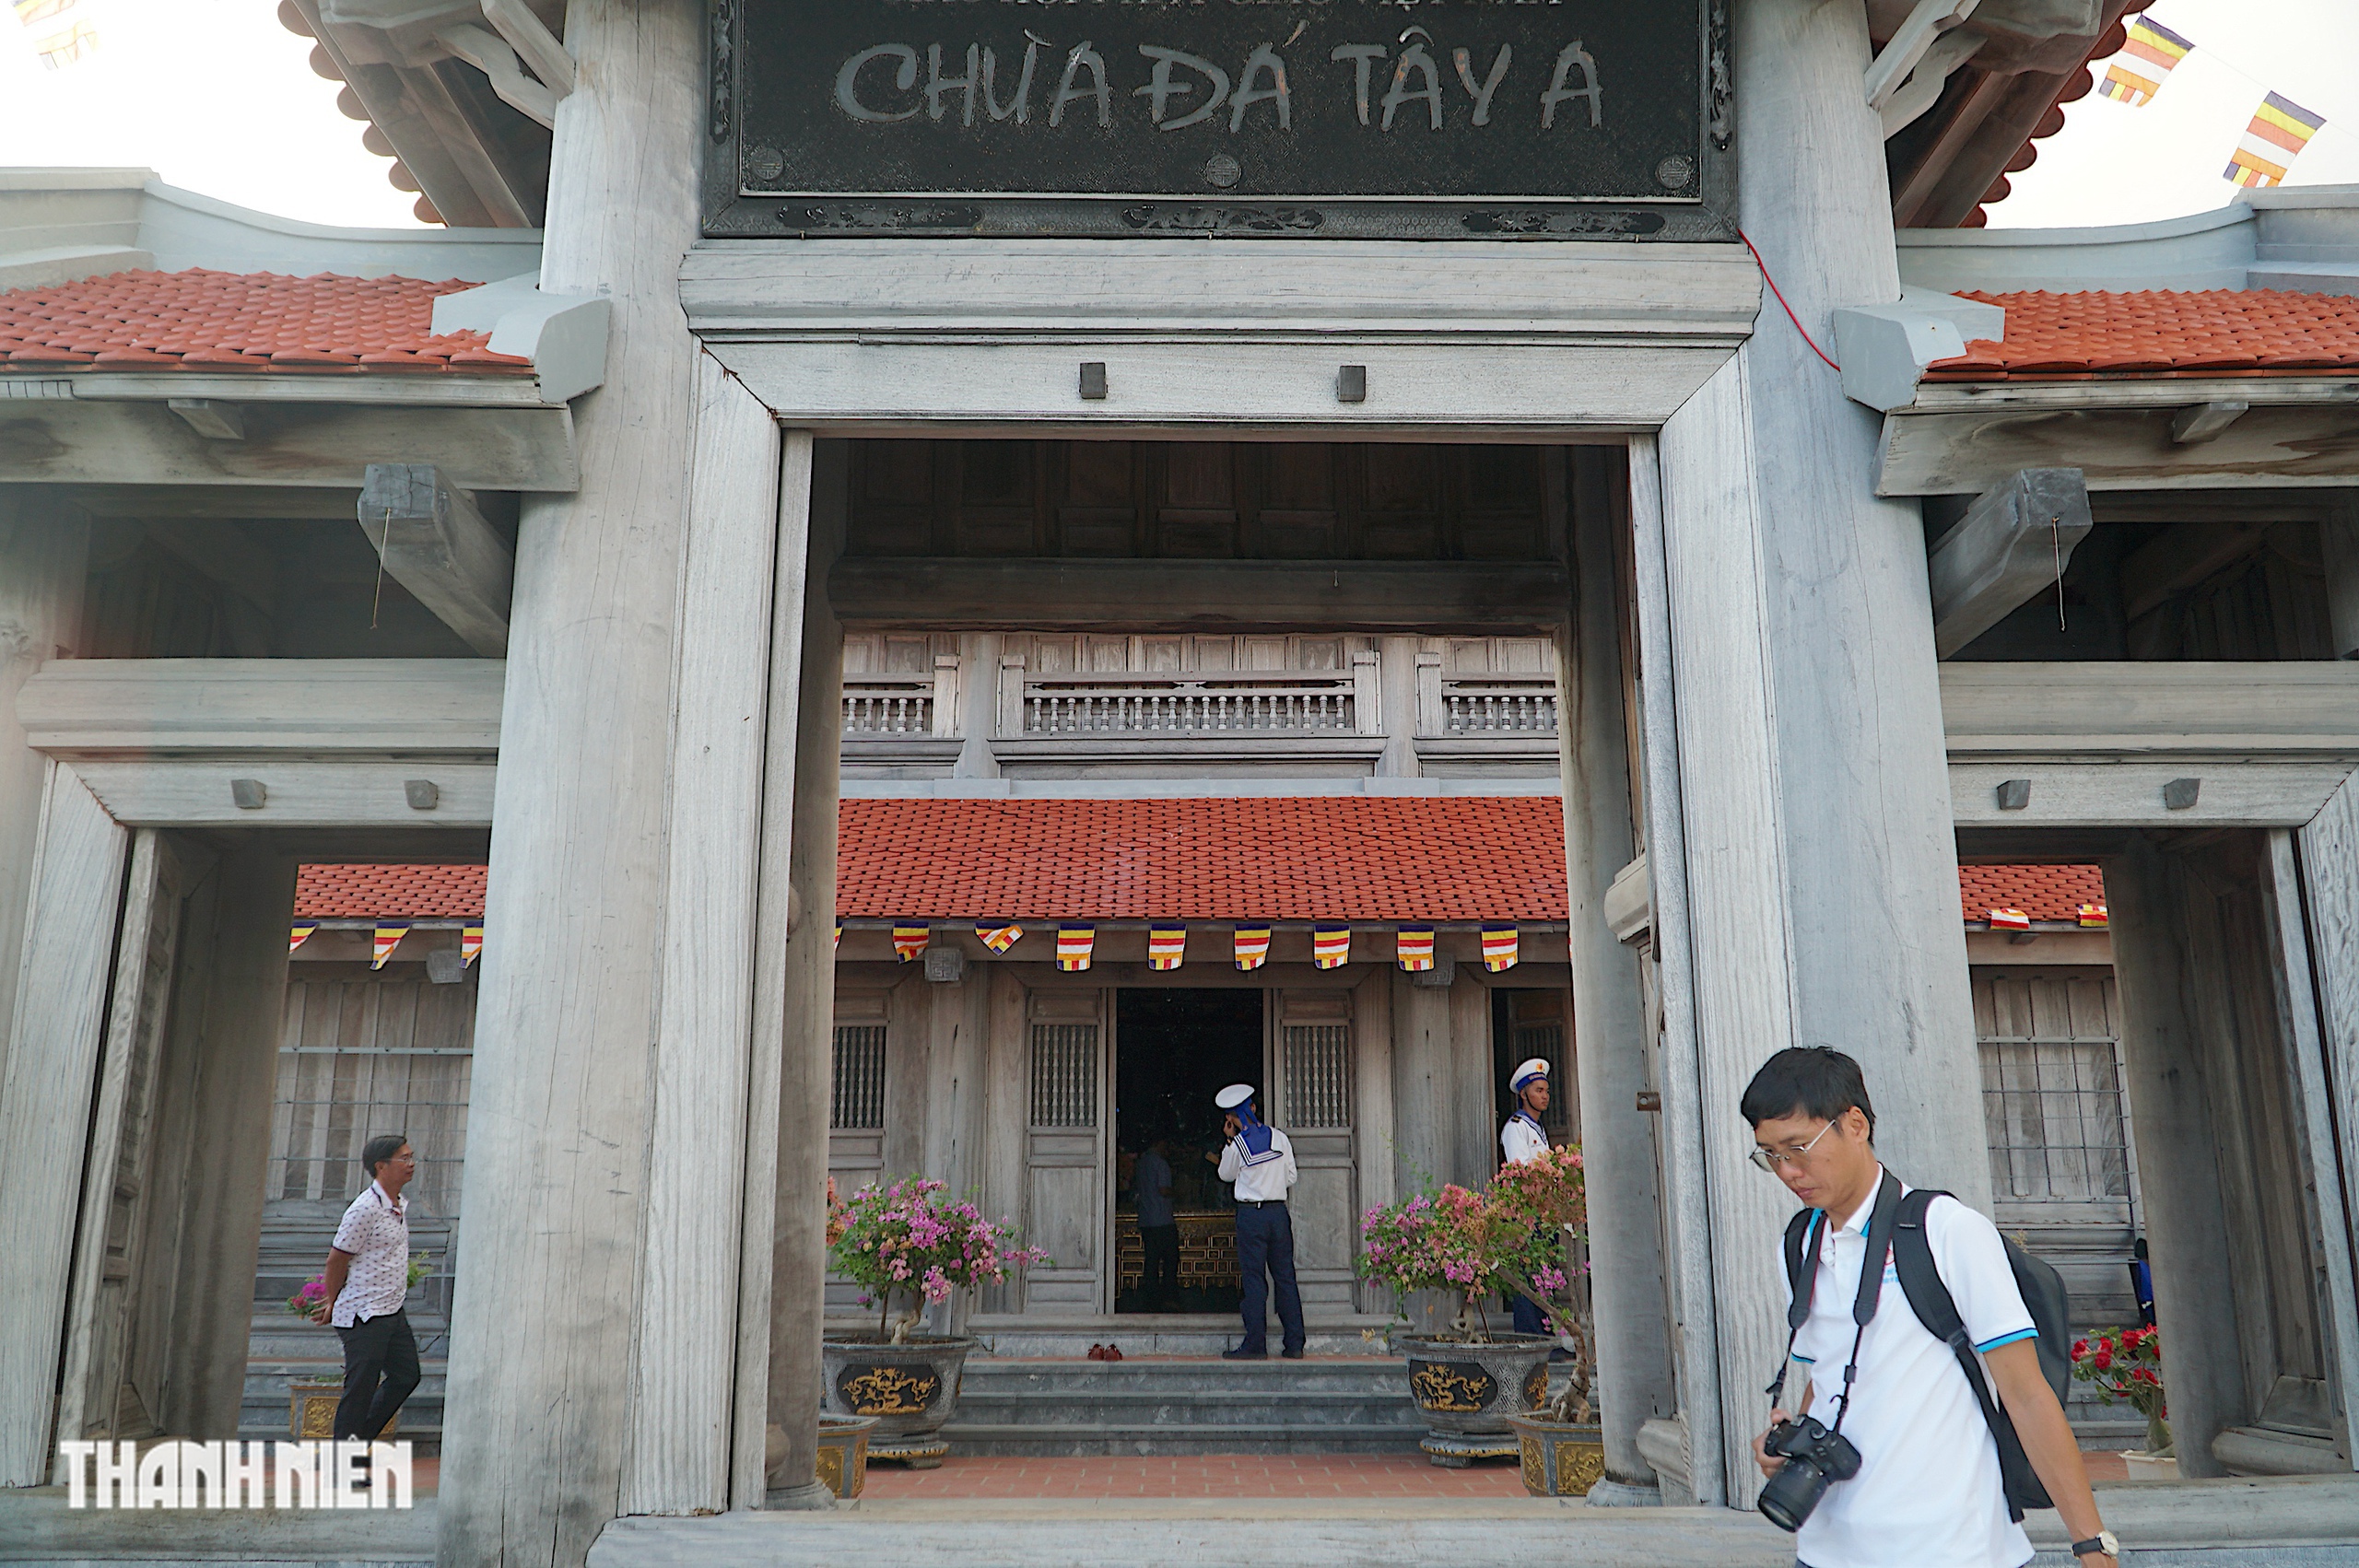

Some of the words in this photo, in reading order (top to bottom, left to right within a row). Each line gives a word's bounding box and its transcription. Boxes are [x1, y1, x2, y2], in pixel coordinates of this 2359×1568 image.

[835, 29, 1109, 128] CHÙA
[1134, 19, 1307, 133] ĐÁ
[1331, 25, 1512, 131] TÂY
[1541, 40, 1602, 129] A
